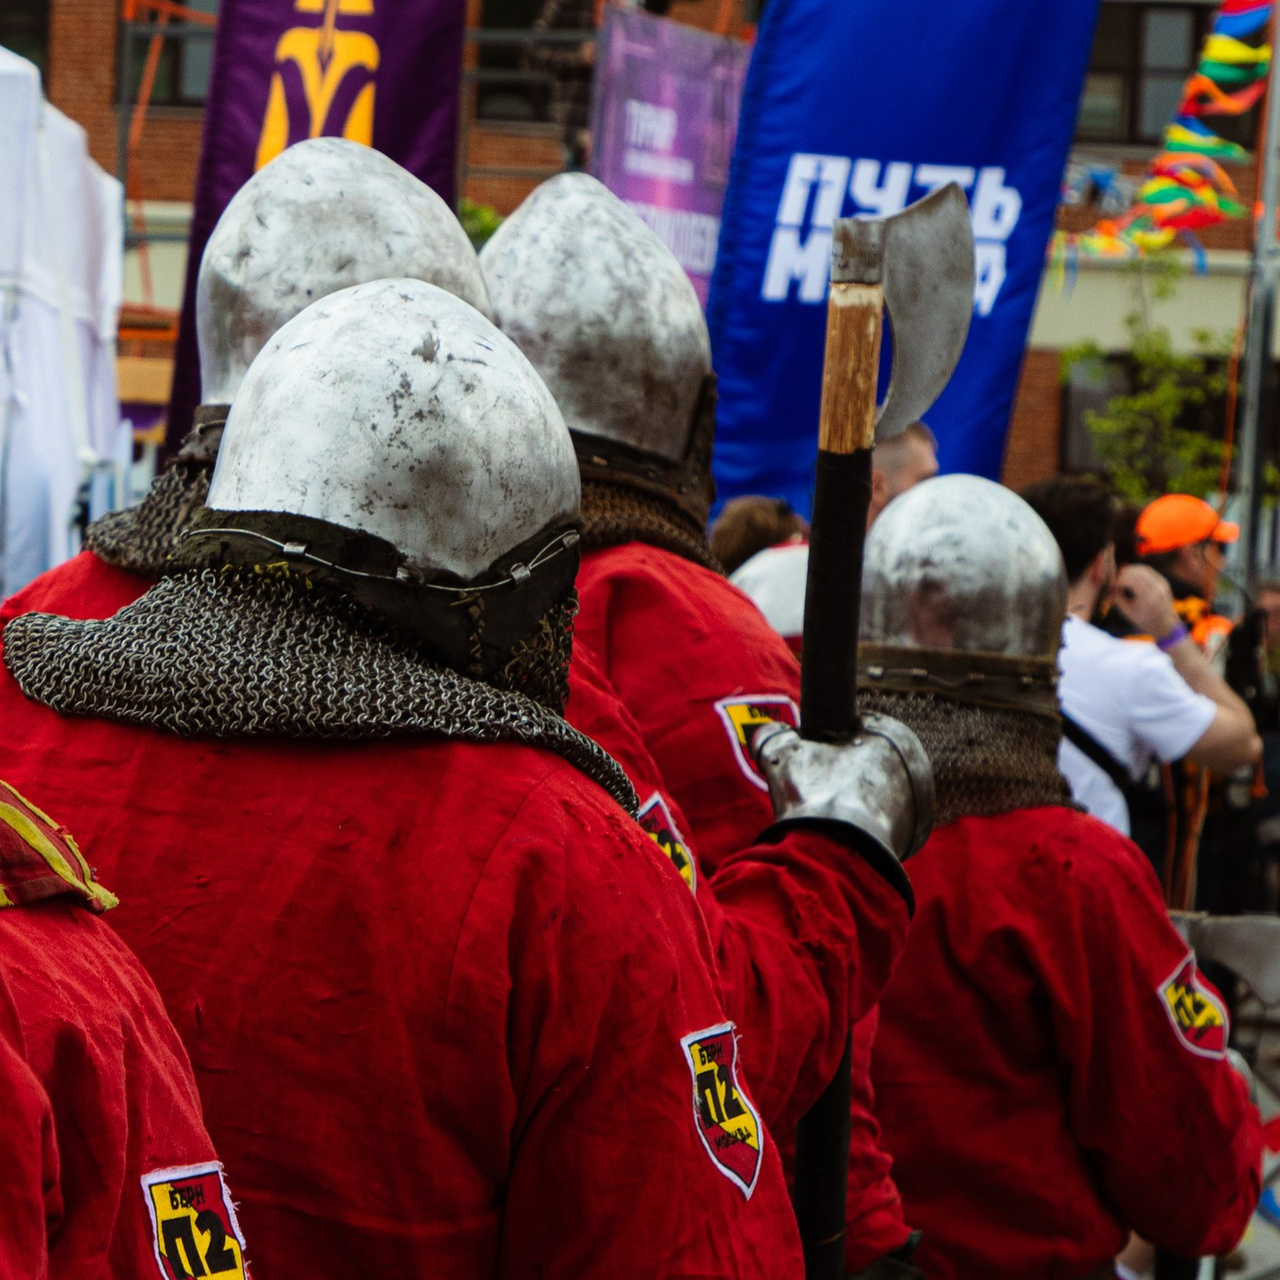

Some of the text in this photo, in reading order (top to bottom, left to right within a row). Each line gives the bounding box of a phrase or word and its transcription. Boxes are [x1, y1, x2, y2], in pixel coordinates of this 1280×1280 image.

[696, 1064, 747, 1129] П2
[713, 1126, 753, 1151] МОСКВА
[168, 1183, 206, 1211] БЕРН
[161, 1209, 238, 1280] П2
